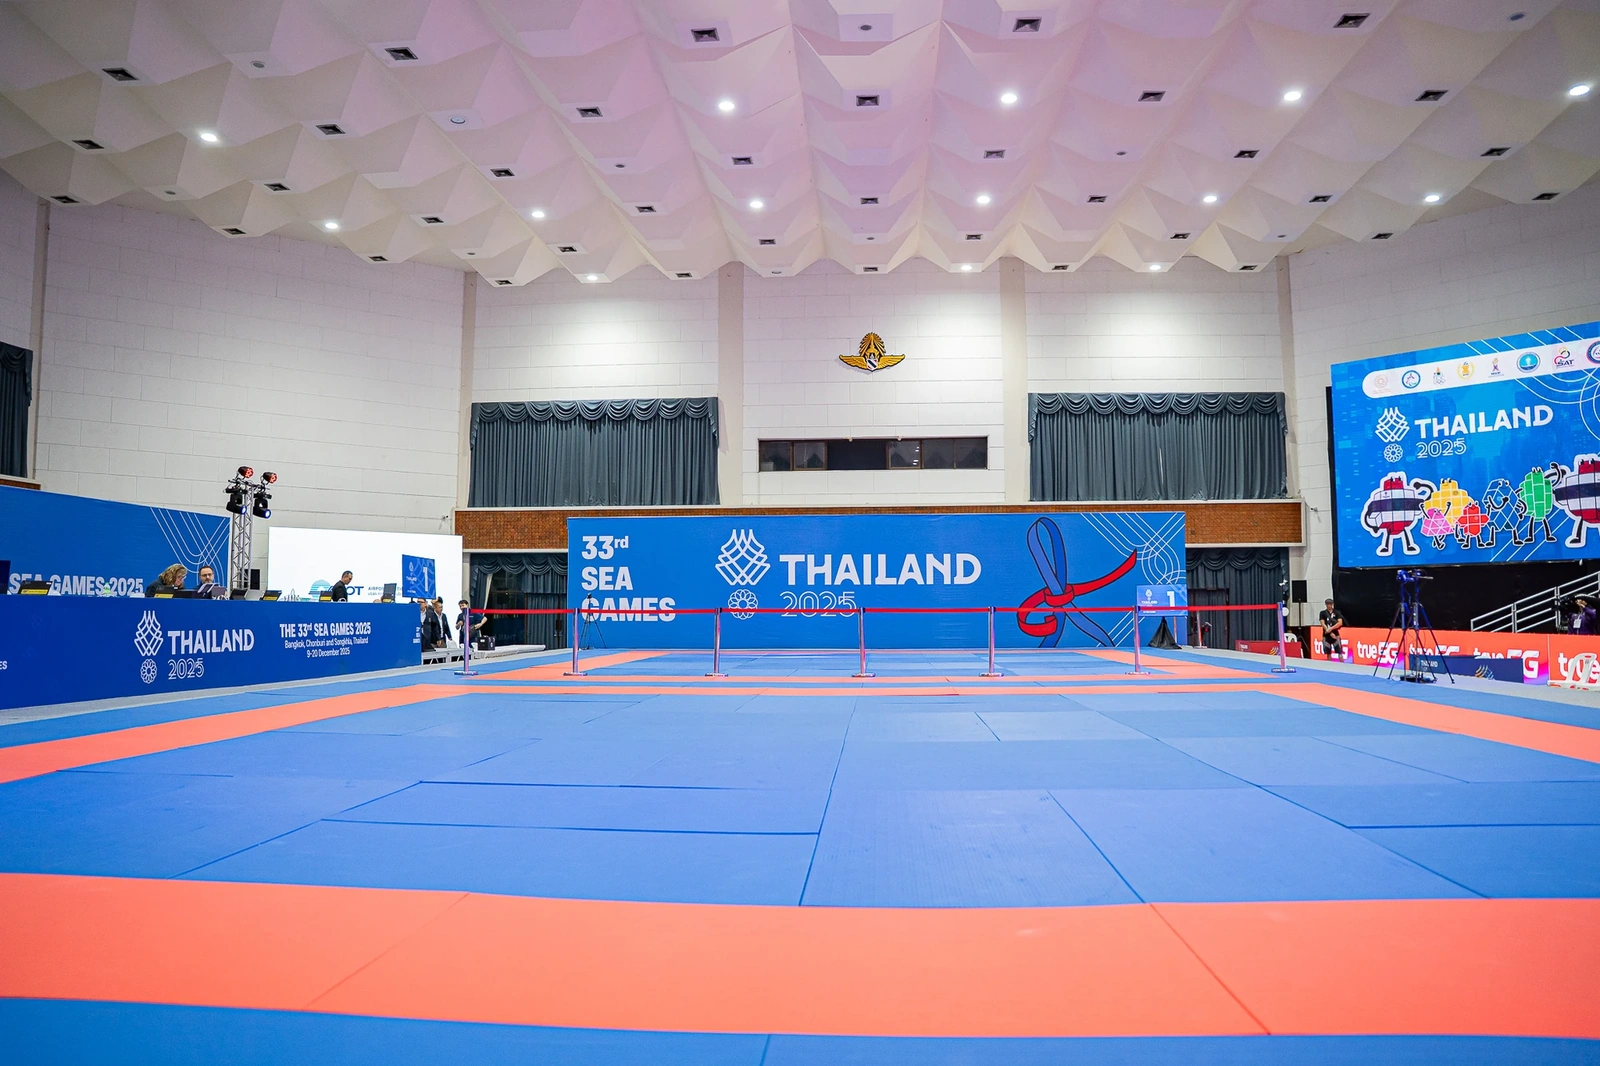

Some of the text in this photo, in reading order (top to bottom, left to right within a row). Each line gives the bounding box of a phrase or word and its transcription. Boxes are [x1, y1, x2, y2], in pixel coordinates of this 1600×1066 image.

[1414, 404, 1554, 439] THAILAND
[1415, 437, 1467, 459] 2025
[581, 535, 629, 560] 33rd
[581, 566, 634, 591] SEA
[779, 553, 982, 586] THAILAND
[108, 577, 144, 596] 2025
[581, 597, 676, 622] GAMES
[779, 590, 857, 618] 2025
[1166, 590, 1176, 612] 1
[167, 628, 255, 655] THAILAND
[279, 621, 371, 638] THE 33rd SEA GAMES 2025
[167, 657, 205, 681] 2025
